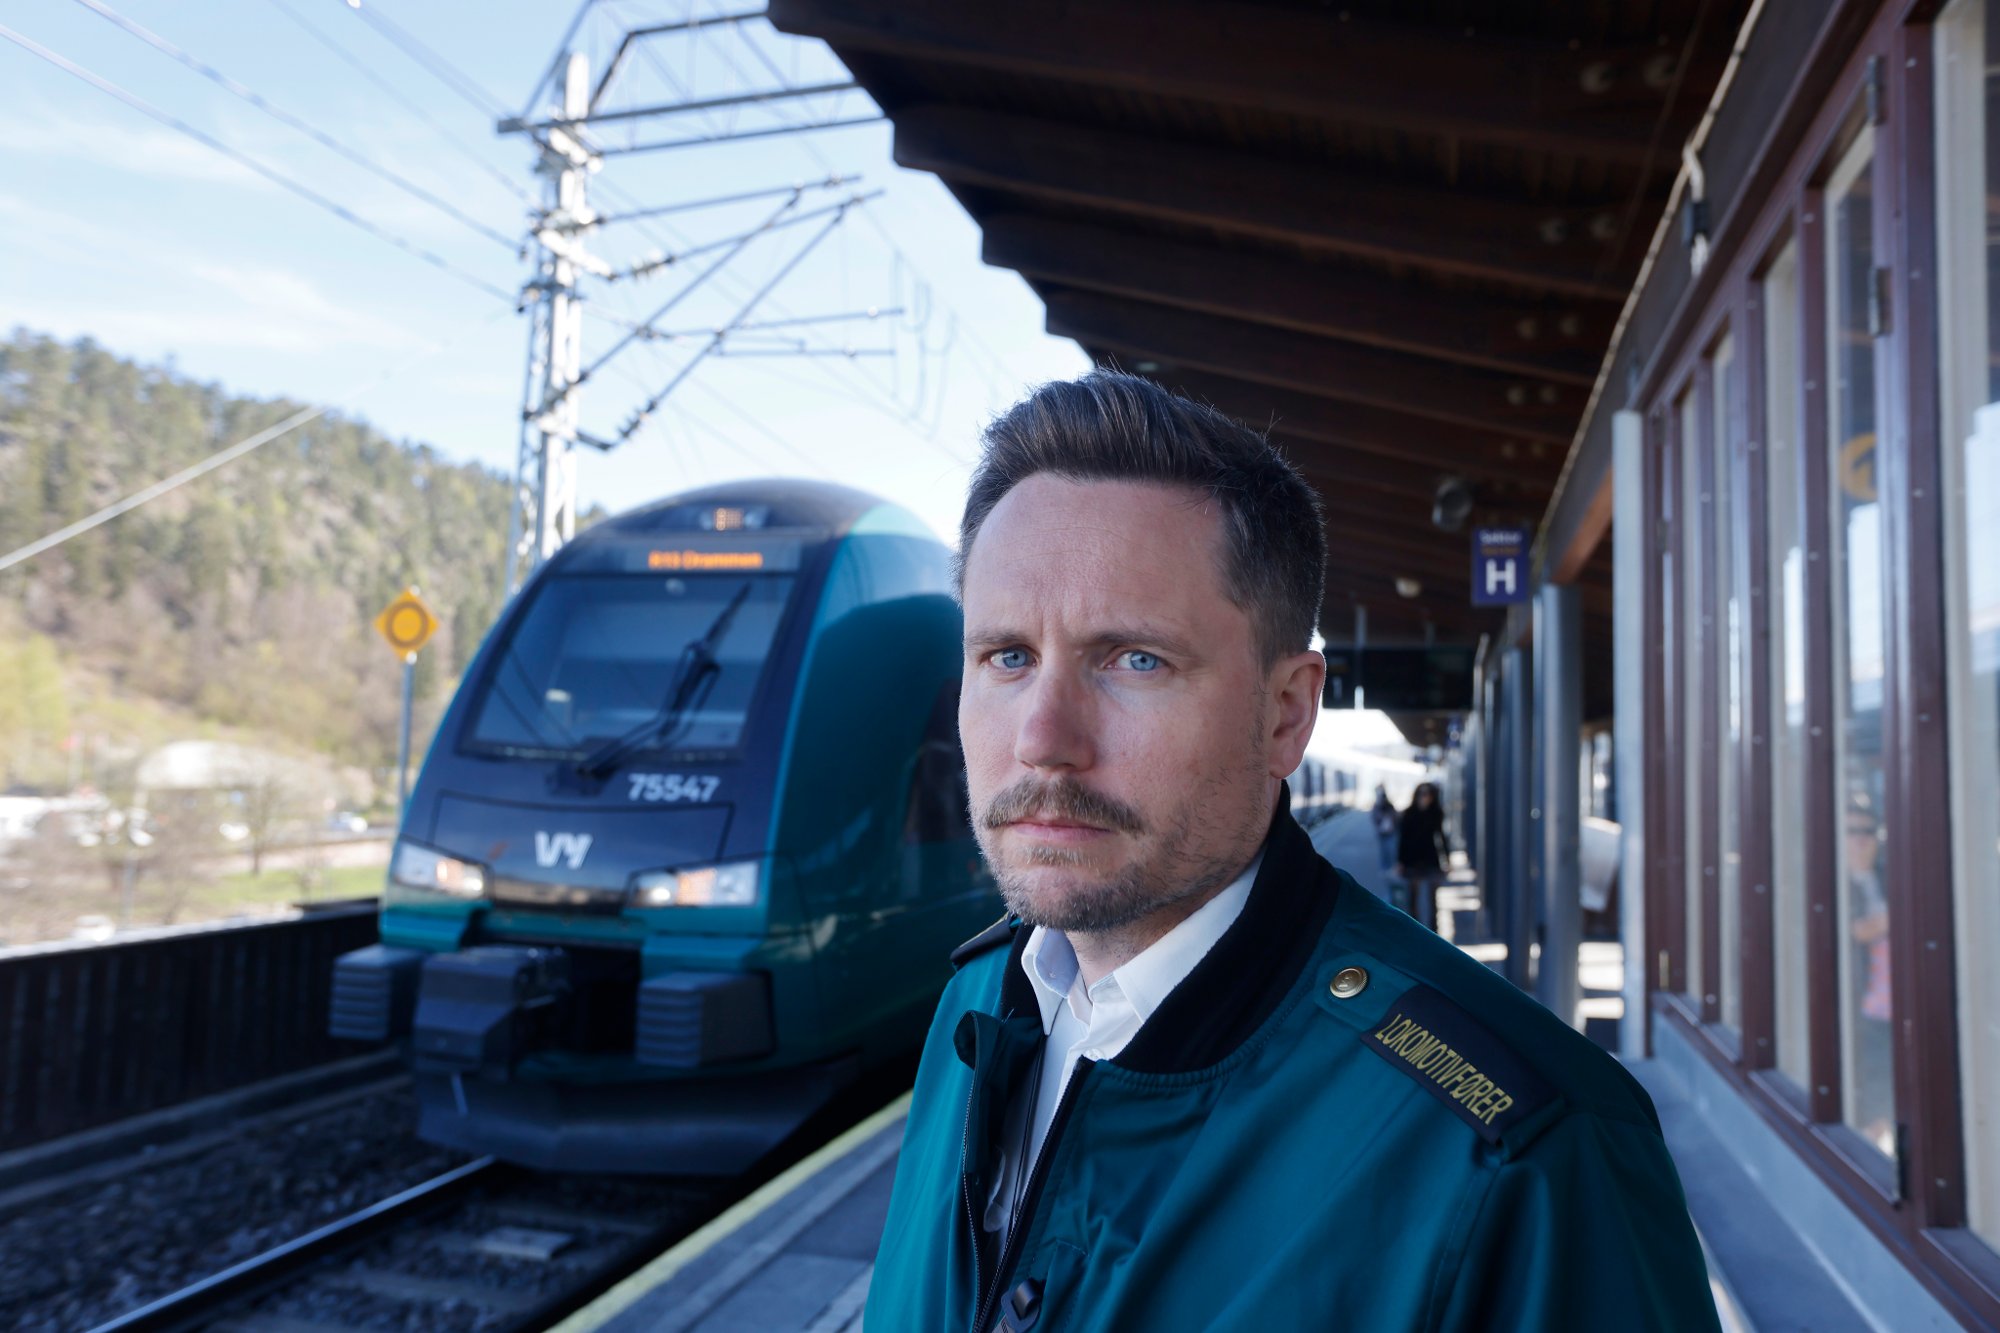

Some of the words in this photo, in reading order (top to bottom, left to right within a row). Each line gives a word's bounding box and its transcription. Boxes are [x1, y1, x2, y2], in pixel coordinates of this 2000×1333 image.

[1486, 559, 1516, 595] H
[628, 773, 720, 802] 75547
[1375, 1013, 1514, 1126] LOKOMOTIVFØRER
